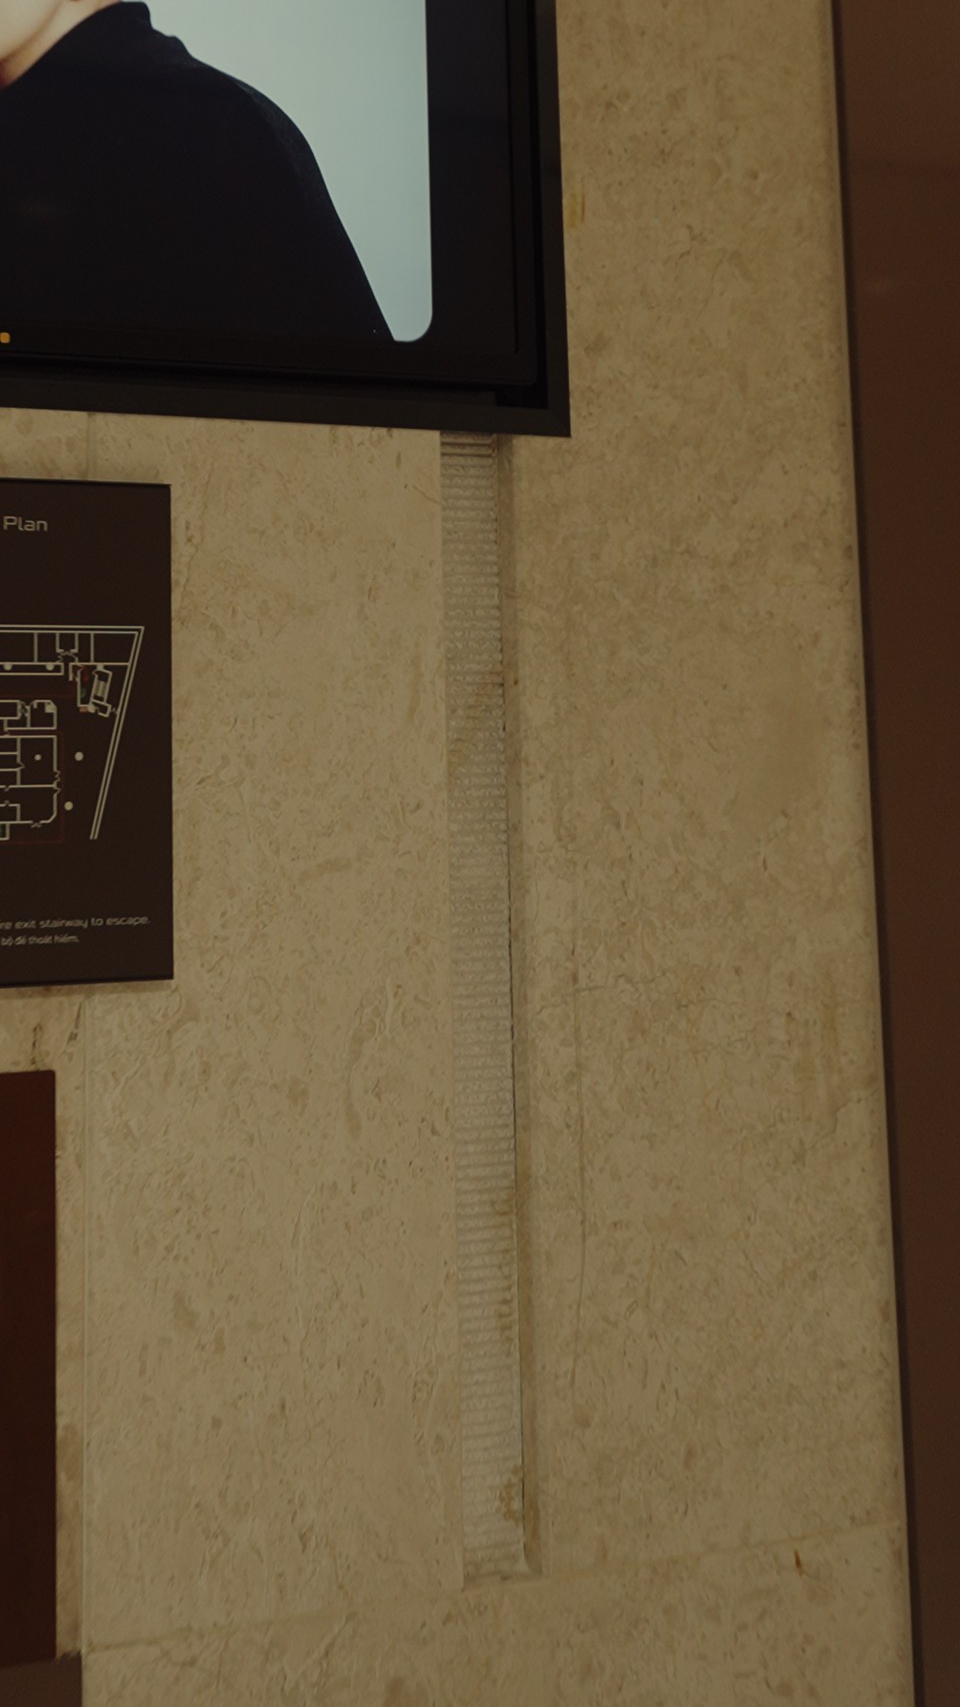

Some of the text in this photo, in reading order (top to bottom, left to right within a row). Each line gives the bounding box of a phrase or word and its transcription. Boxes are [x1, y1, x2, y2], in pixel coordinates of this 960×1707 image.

[3, 515, 48, 532] Plan
[14, 919, 36, 930] exit
[39, 917, 88, 930] stairway
[90, 917, 104, 927] to
